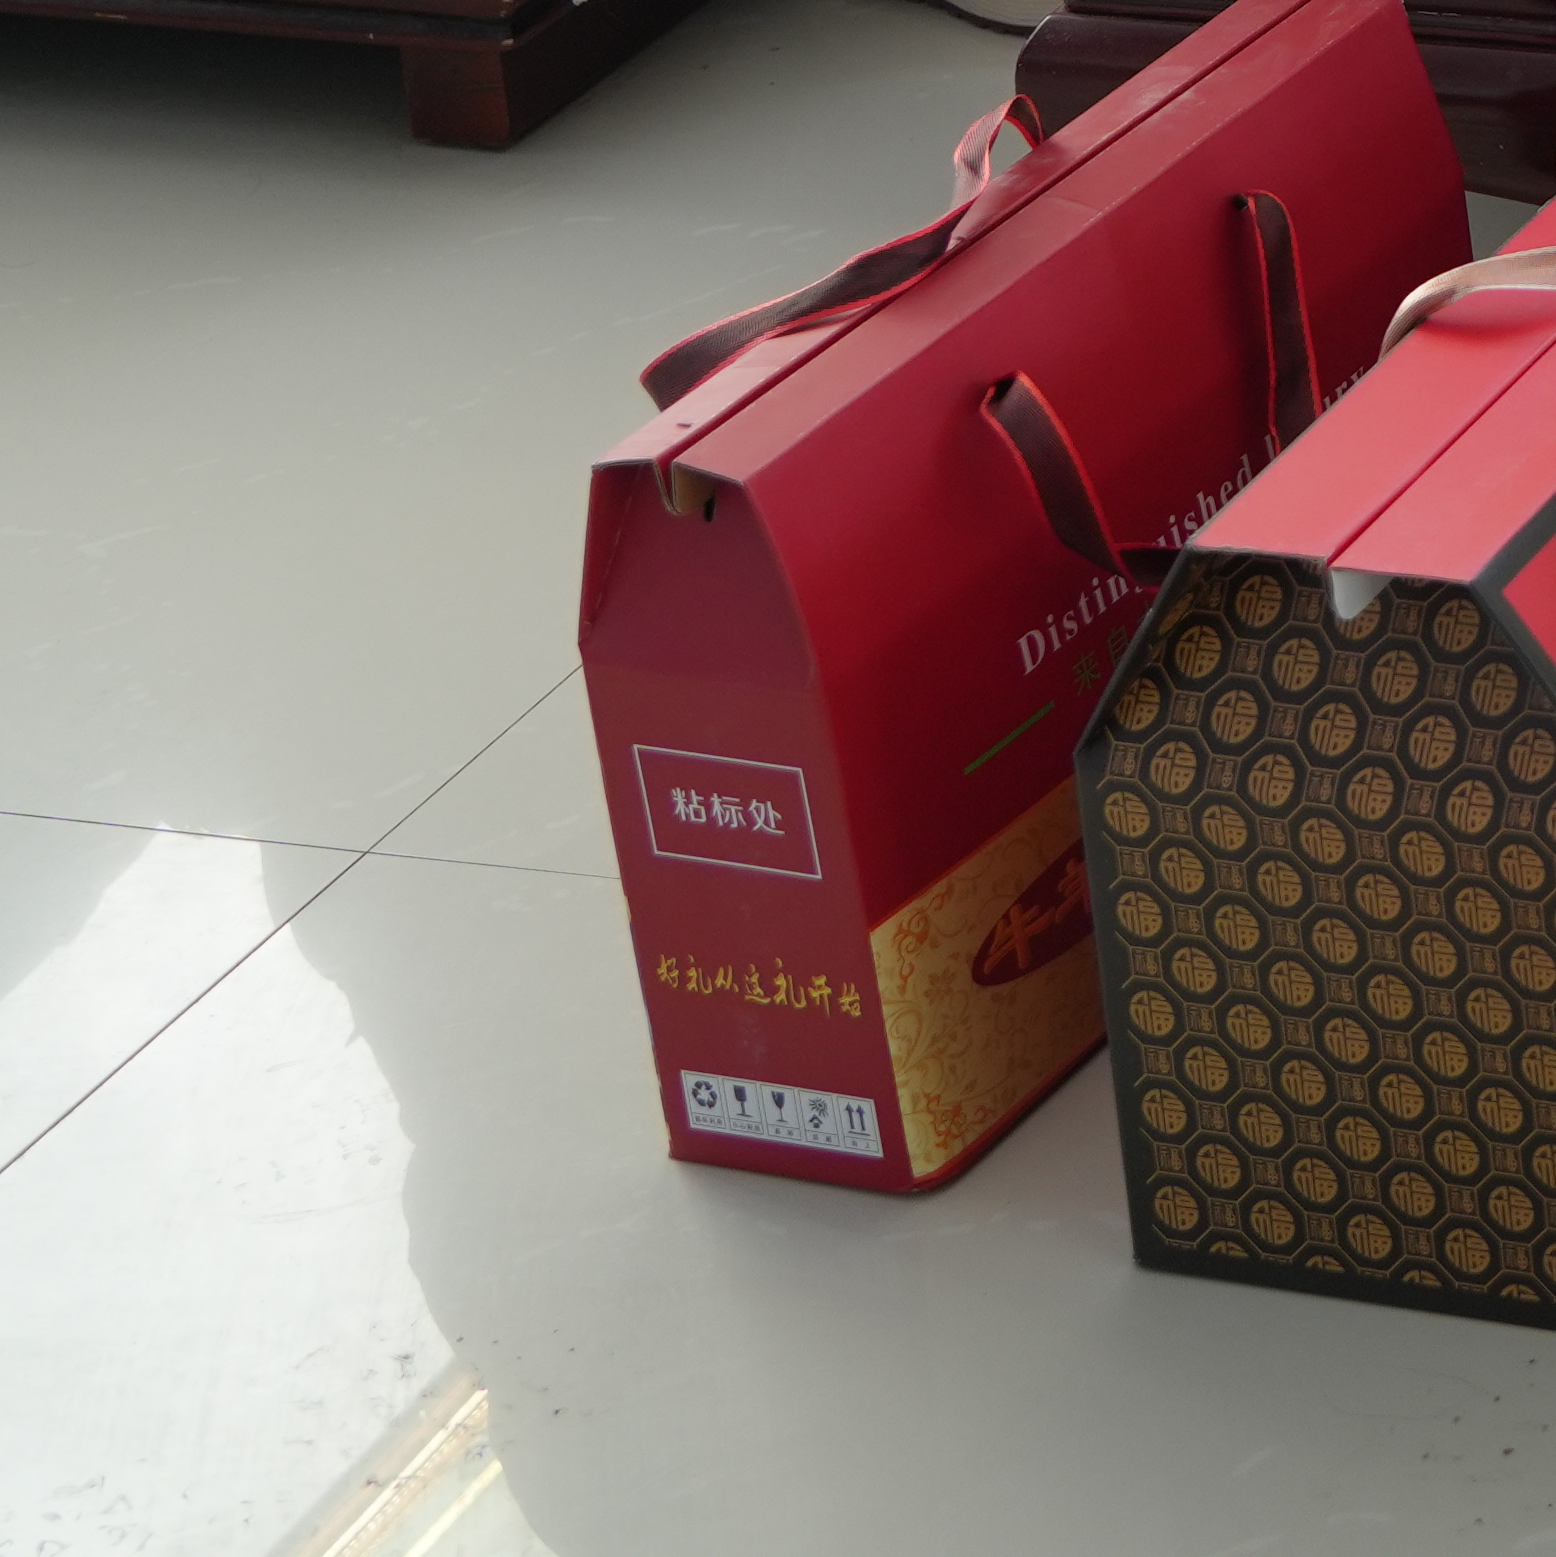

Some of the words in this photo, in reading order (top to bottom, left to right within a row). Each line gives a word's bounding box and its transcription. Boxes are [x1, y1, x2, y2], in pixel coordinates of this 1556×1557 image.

[1015, 454, 1254, 676] Distinuished
[670, 786, 786, 836] 粘标处
